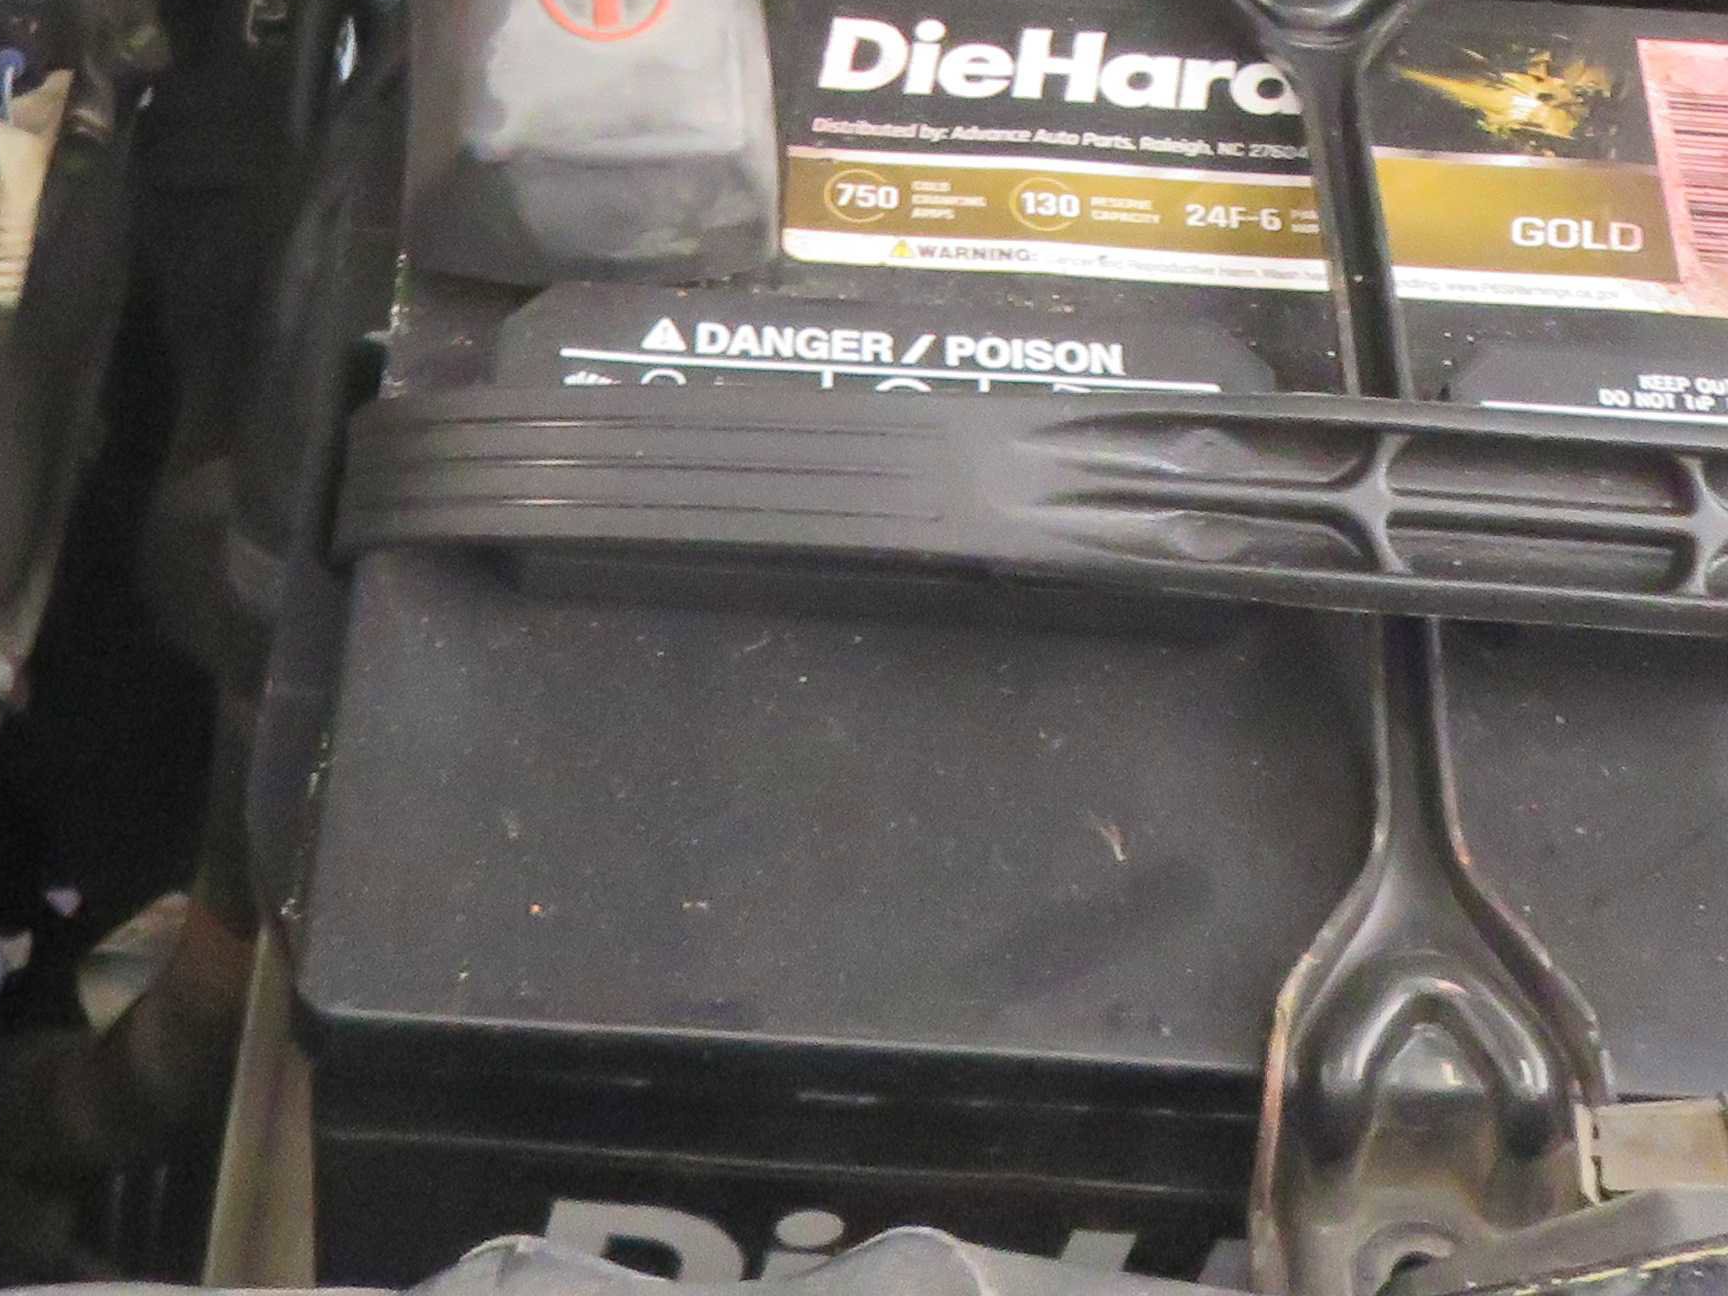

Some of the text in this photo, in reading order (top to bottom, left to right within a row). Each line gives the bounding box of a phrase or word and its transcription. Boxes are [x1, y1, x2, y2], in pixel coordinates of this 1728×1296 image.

[950, 124, 1032, 143] Advance
[1032, 128, 1080, 146] Auto
[834, 182, 900, 209] 750
[1021, 190, 1081, 218] 130
[1184, 203, 1282, 232] 24F-6
[1510, 215, 1644, 253] GOLD
[916, 243, 1038, 263] WARNING:
[695, 320, 1125, 376] DANGER / POISON
[1637, 374, 1692, 393] KEEP
[1598, 387, 1631, 407] DO
[1633, 390, 1676, 409] NOT
